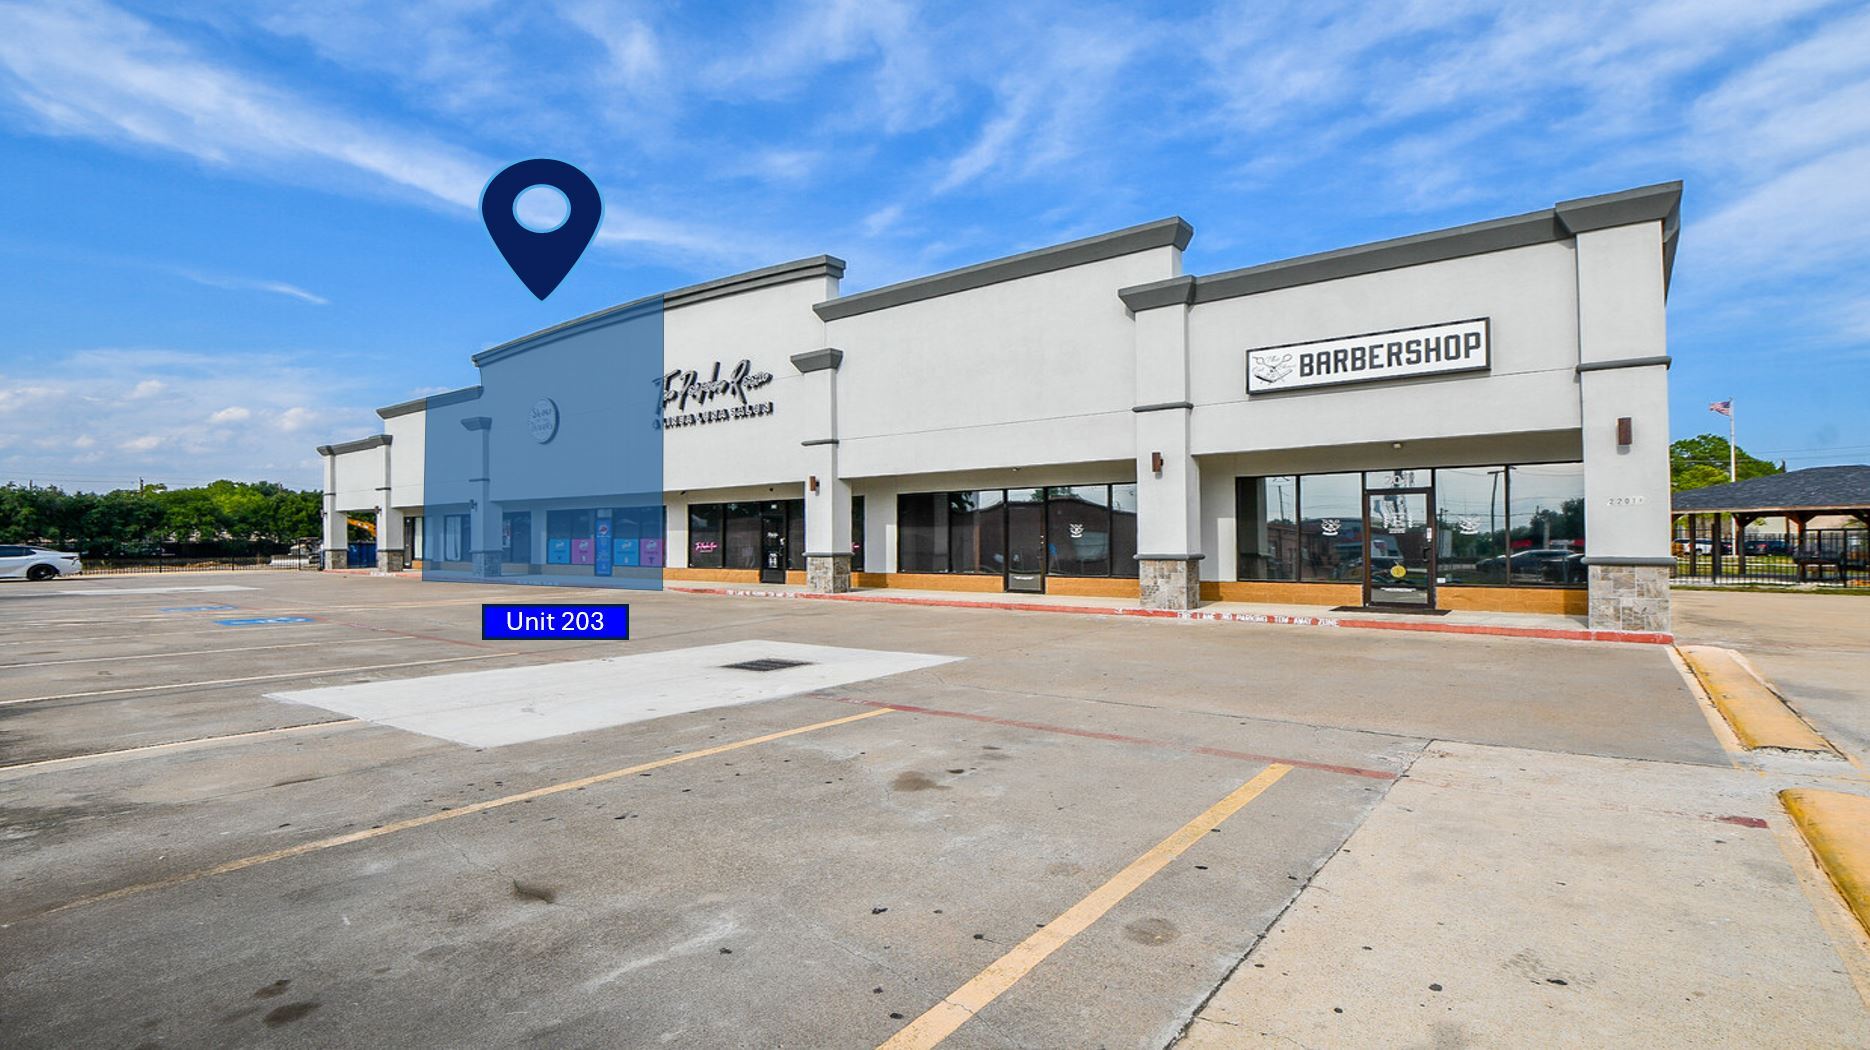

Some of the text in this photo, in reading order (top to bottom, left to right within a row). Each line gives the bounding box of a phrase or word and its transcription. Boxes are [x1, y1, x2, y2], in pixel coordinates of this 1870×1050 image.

[1299, 332, 1481, 378] BARBERSHOP
[1221, 613, 1233, 621] NO
[1236, 614, 1268, 623] PARKING
[1274, 615, 1289, 624] TOW
[1294, 616, 1312, 625] AWAY
[1318, 618, 1338, 627] ZONE
